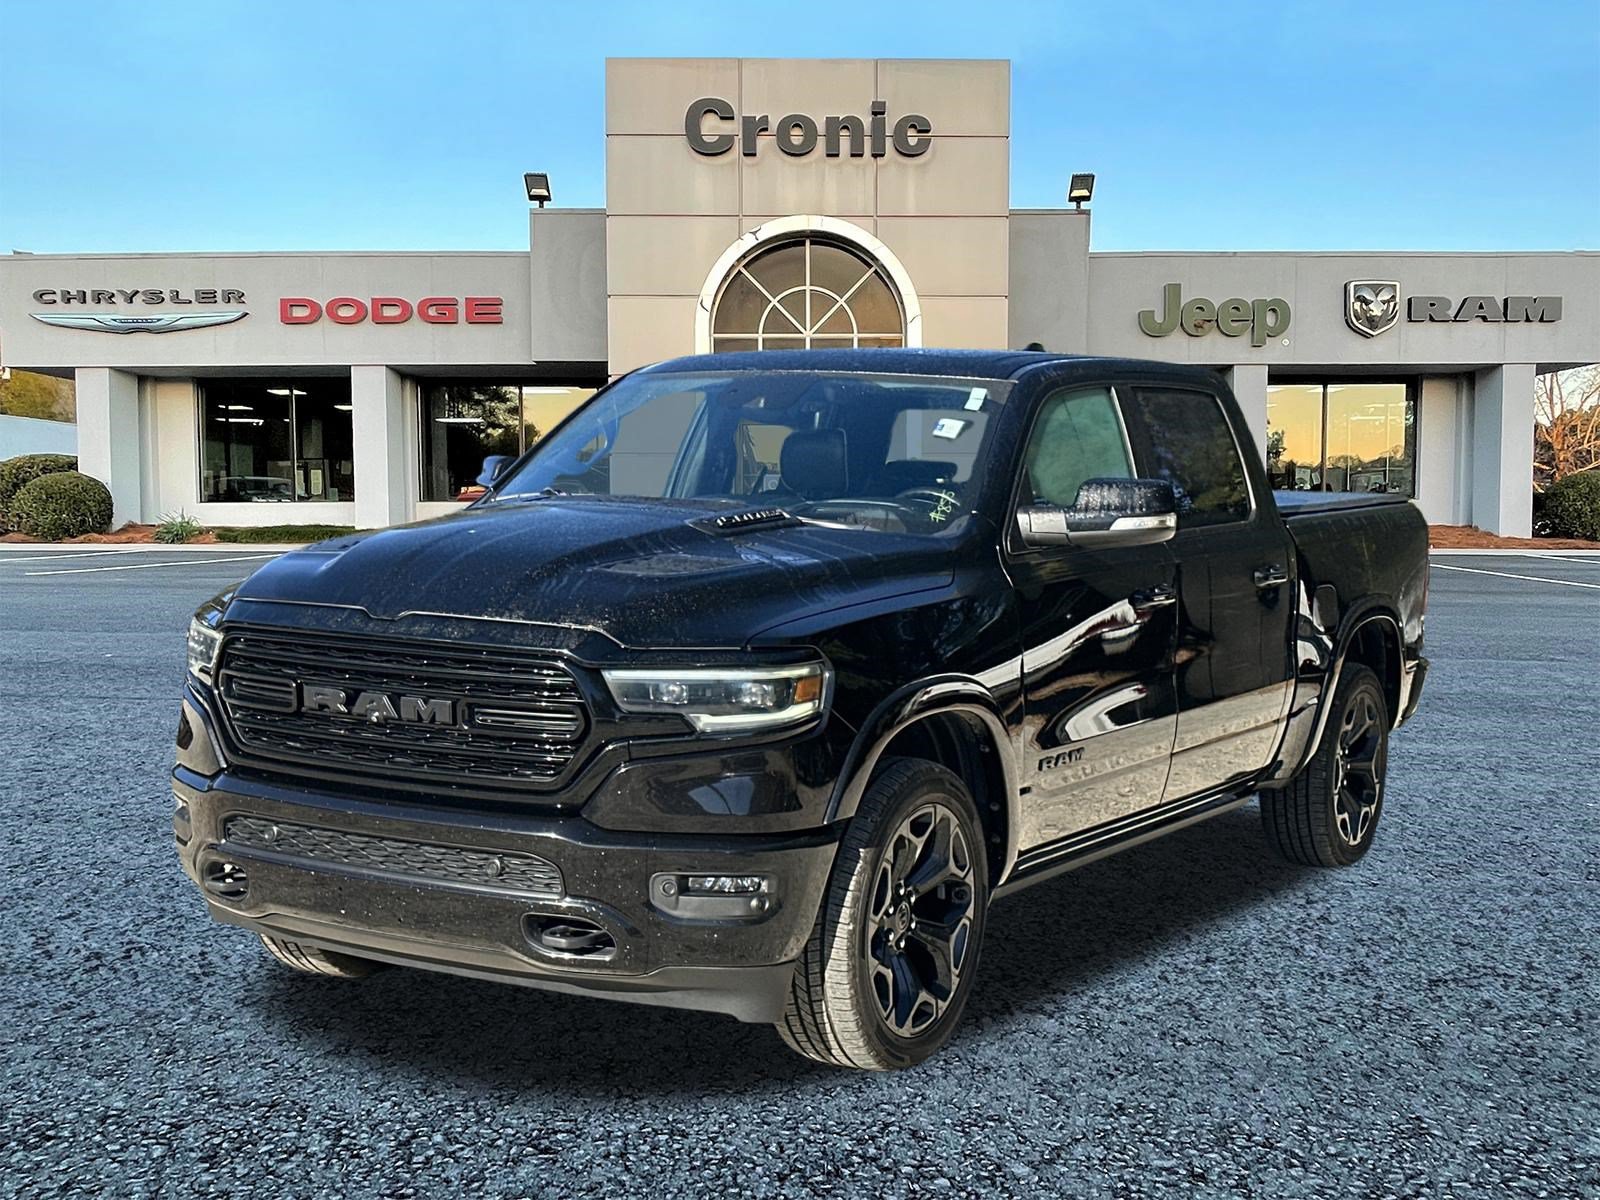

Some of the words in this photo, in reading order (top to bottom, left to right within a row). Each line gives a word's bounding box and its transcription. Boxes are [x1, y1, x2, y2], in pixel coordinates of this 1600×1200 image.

[685, 98, 932, 157] Cronic
[32, 288, 247, 305] CHRYSLER
[1407, 296, 1563, 322] RAM
[280, 297, 503, 324] DODGE
[1138, 283, 1291, 347] Jeep
[301, 684, 453, 726] RAM
[1038, 746, 1085, 771] RAM
